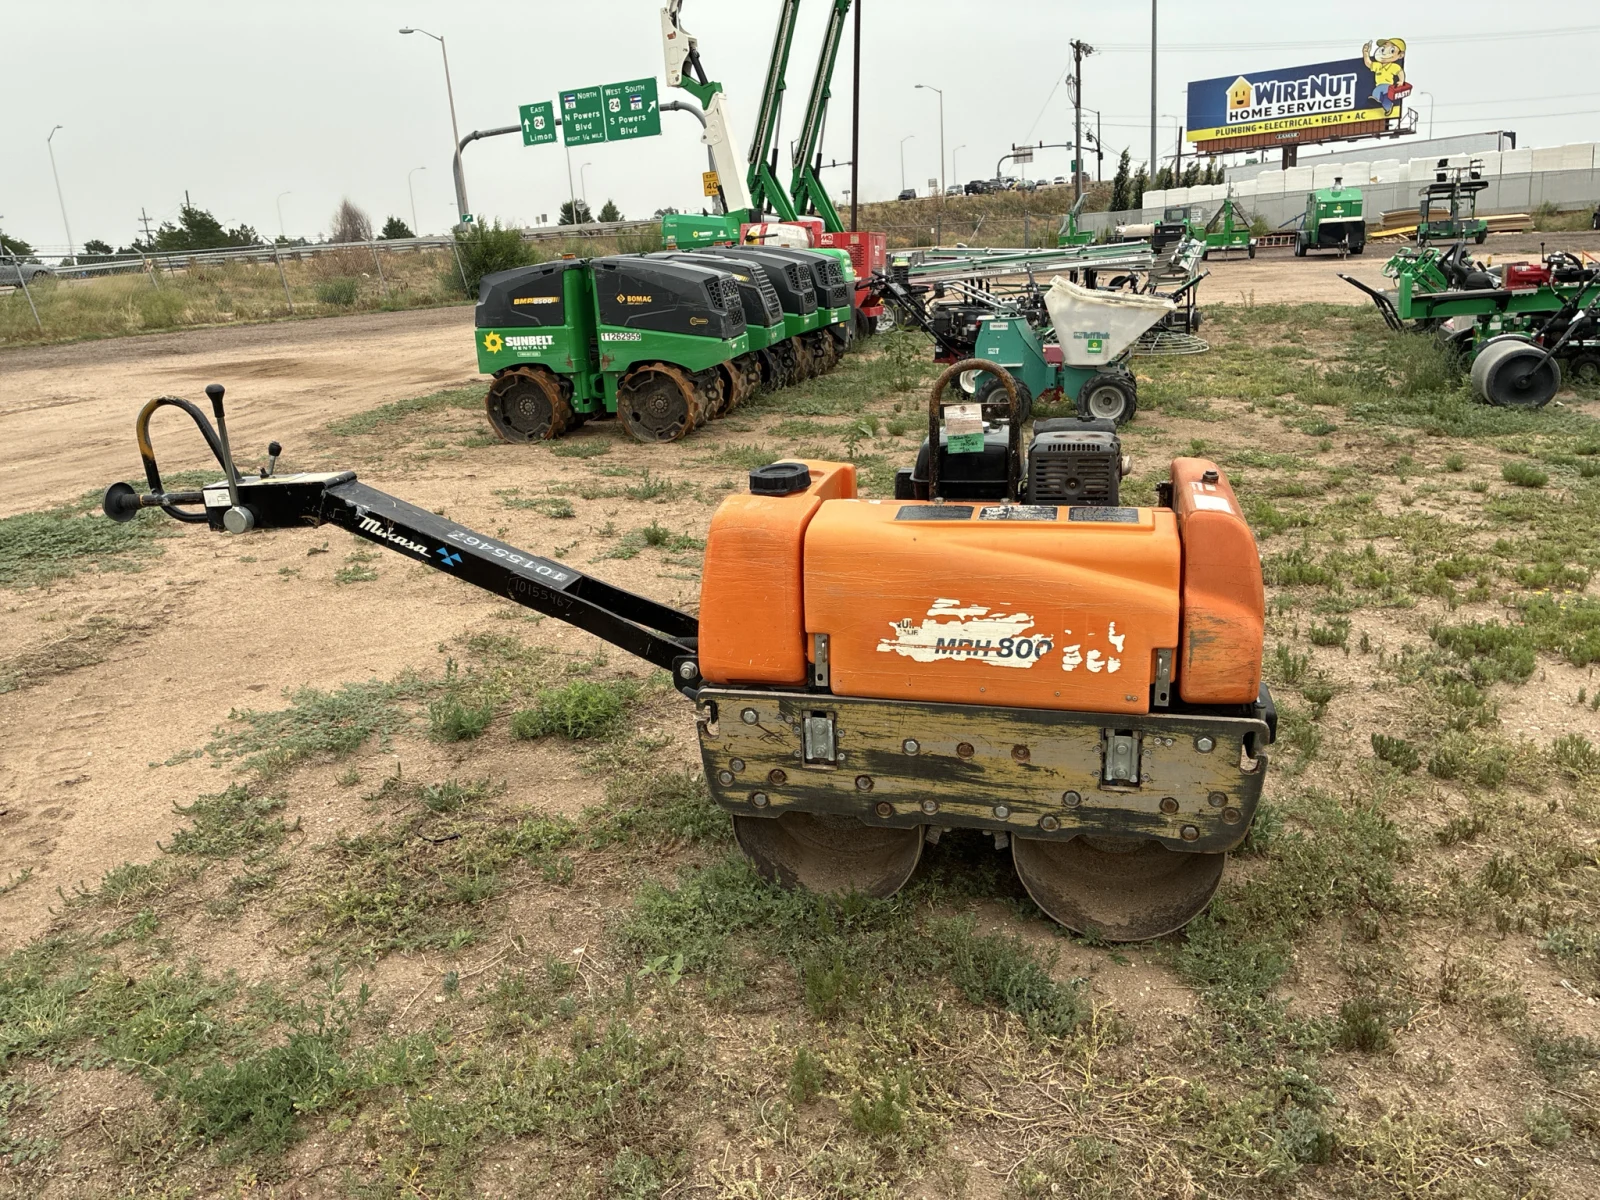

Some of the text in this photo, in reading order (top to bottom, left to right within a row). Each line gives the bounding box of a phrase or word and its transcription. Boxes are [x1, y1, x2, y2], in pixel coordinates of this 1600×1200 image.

[605, 85, 645, 96] WEST SOUTH
[577, 92, 597, 100] NORTH
[530, 105, 545, 114] EAST
[610, 100, 620, 110] 24
[1229, 97, 1352, 121] HOME SERVICES
[574, 112, 600, 120] Powers
[618, 114, 646, 124] Powers
[534, 118, 544, 128] 24
[575, 122, 592, 131] Blvd
[1215, 125, 1256, 136] PLUMBING
[1264, 118, 1313, 130] ELECTRICAL
[1321, 114, 1343, 124] HEAT
[620, 126, 638, 135] Blvd
[530, 133, 553, 142] Limon
[706, 182, 718, 190] 40
[505, 335, 553, 346] SUNBELT
[359, 514, 432, 558] Mikasa
[446, 530, 569, 582] 10155467
